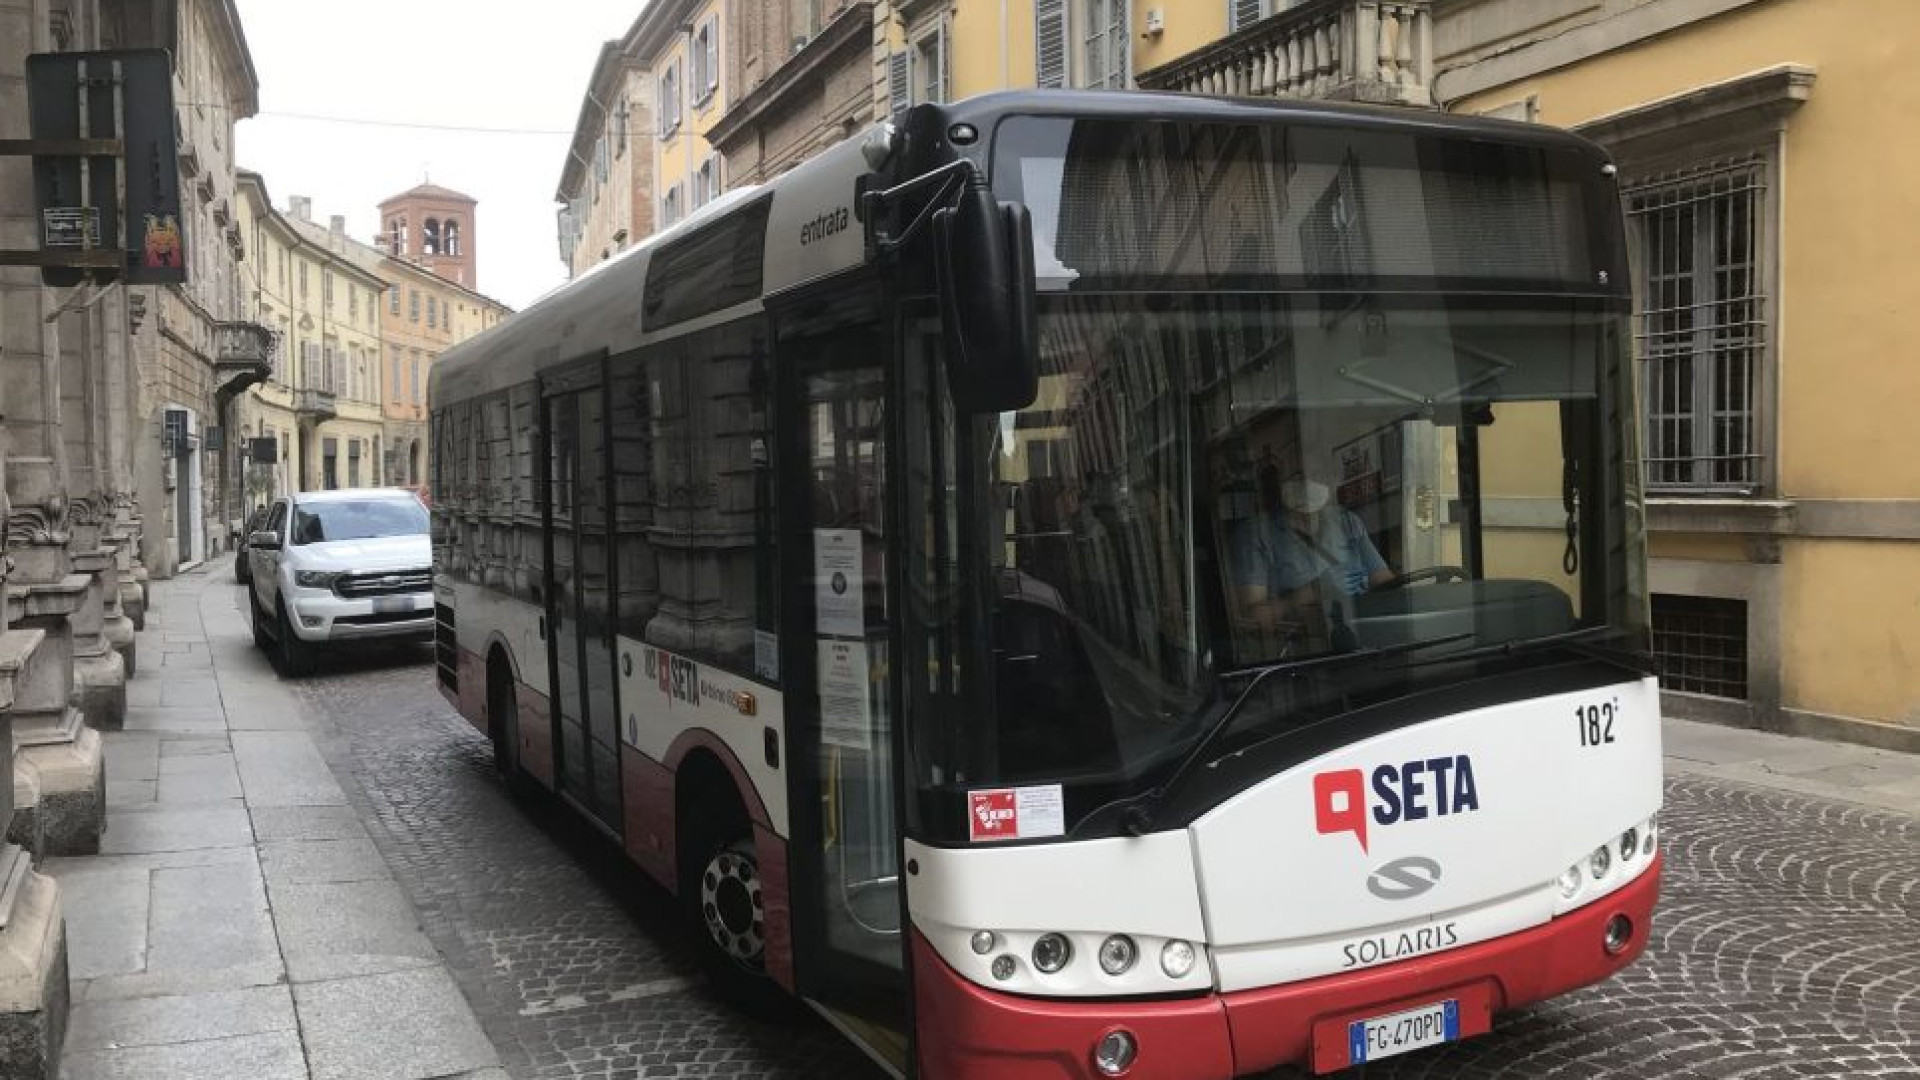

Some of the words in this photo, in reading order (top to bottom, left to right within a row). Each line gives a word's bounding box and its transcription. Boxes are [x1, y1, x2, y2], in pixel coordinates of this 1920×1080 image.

[800, 207, 849, 246] entrata
[670, 654, 700, 707] SETA
[1575, 702, 1615, 747] 182
[1371, 754, 1479, 826] SETA
[1343, 922, 1458, 967] SOLARIS
